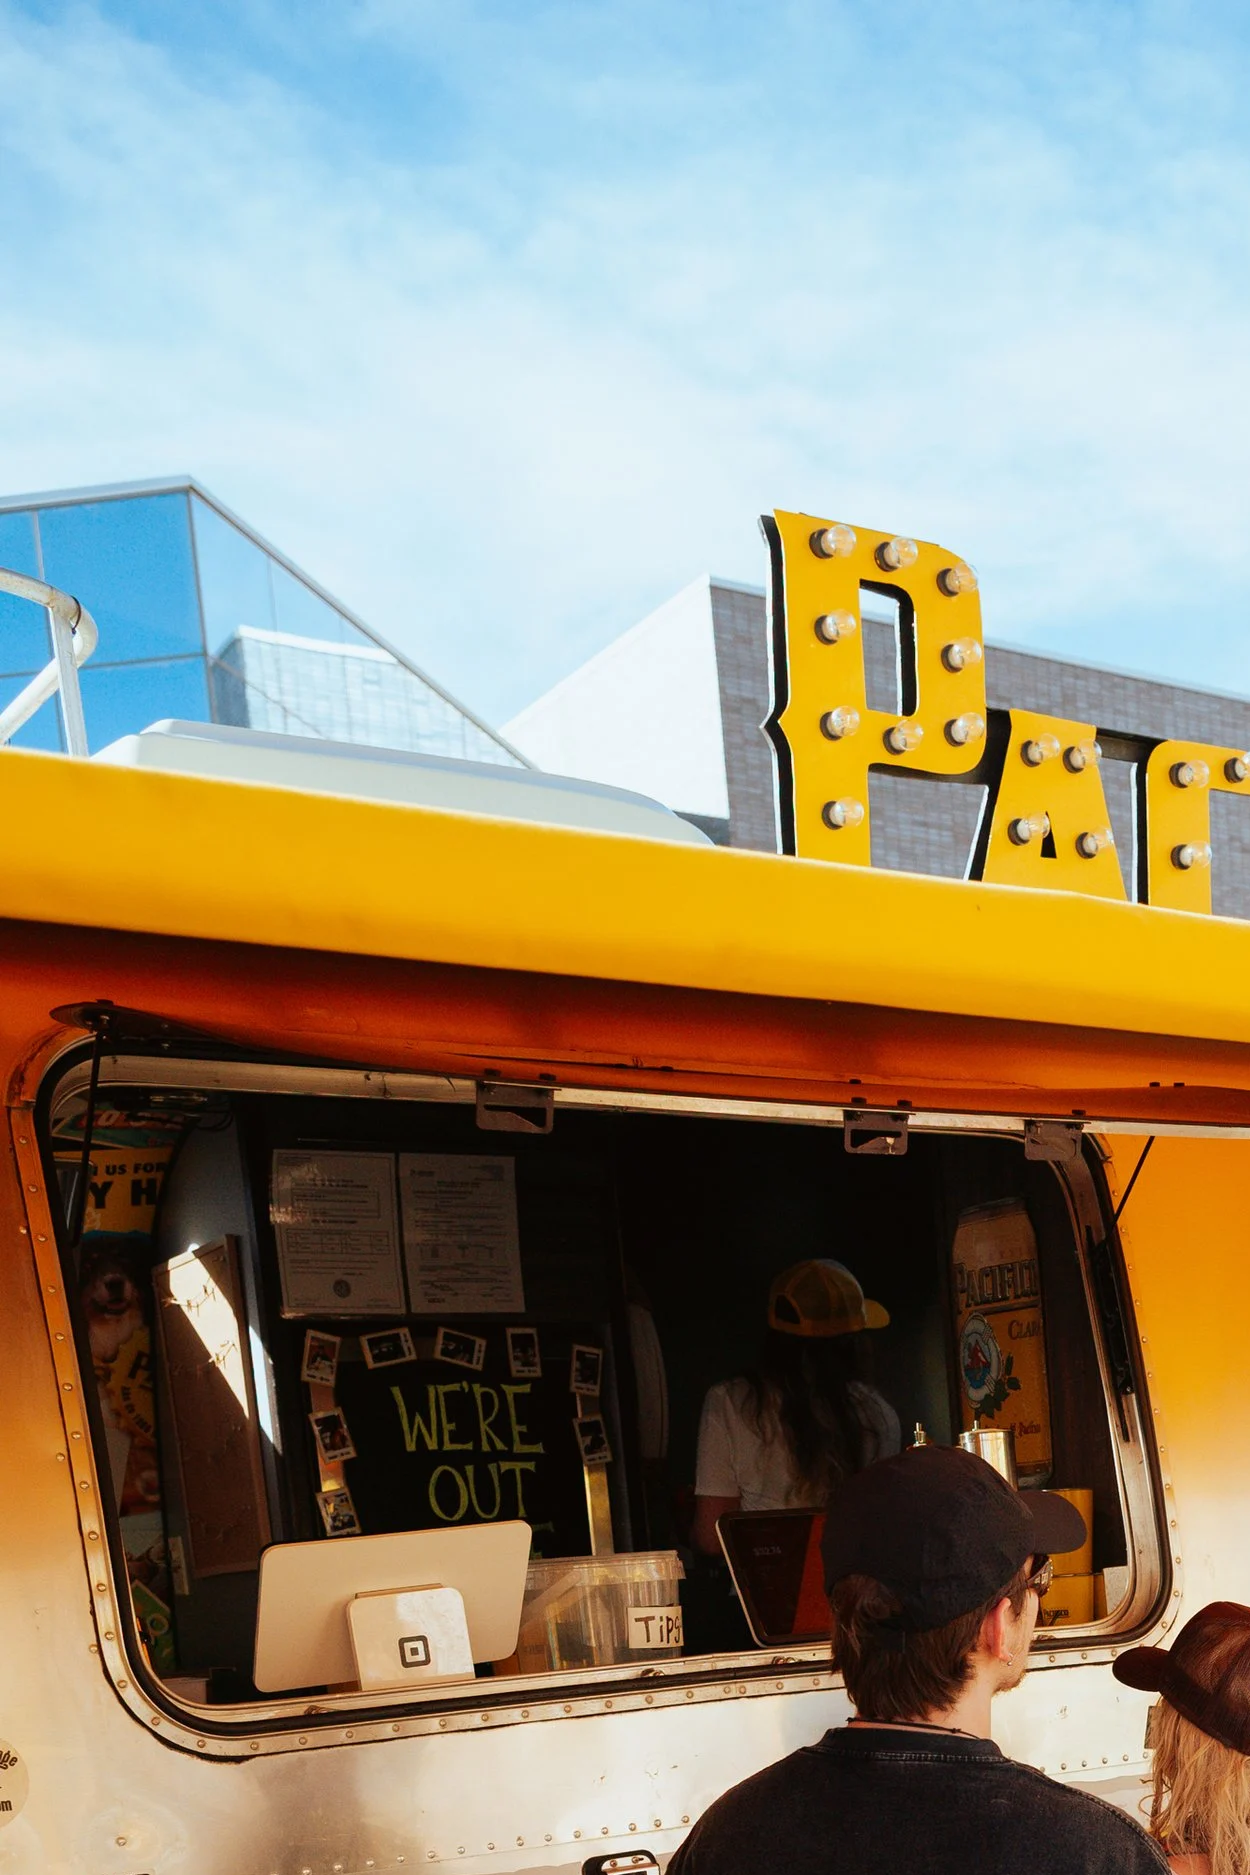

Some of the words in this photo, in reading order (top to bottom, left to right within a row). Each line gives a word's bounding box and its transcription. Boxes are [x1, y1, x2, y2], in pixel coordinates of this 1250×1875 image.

[105, 1163, 127, 1175] US
[389, 1381, 545, 1453] WE'RE
[428, 1461, 536, 1521] OUT
